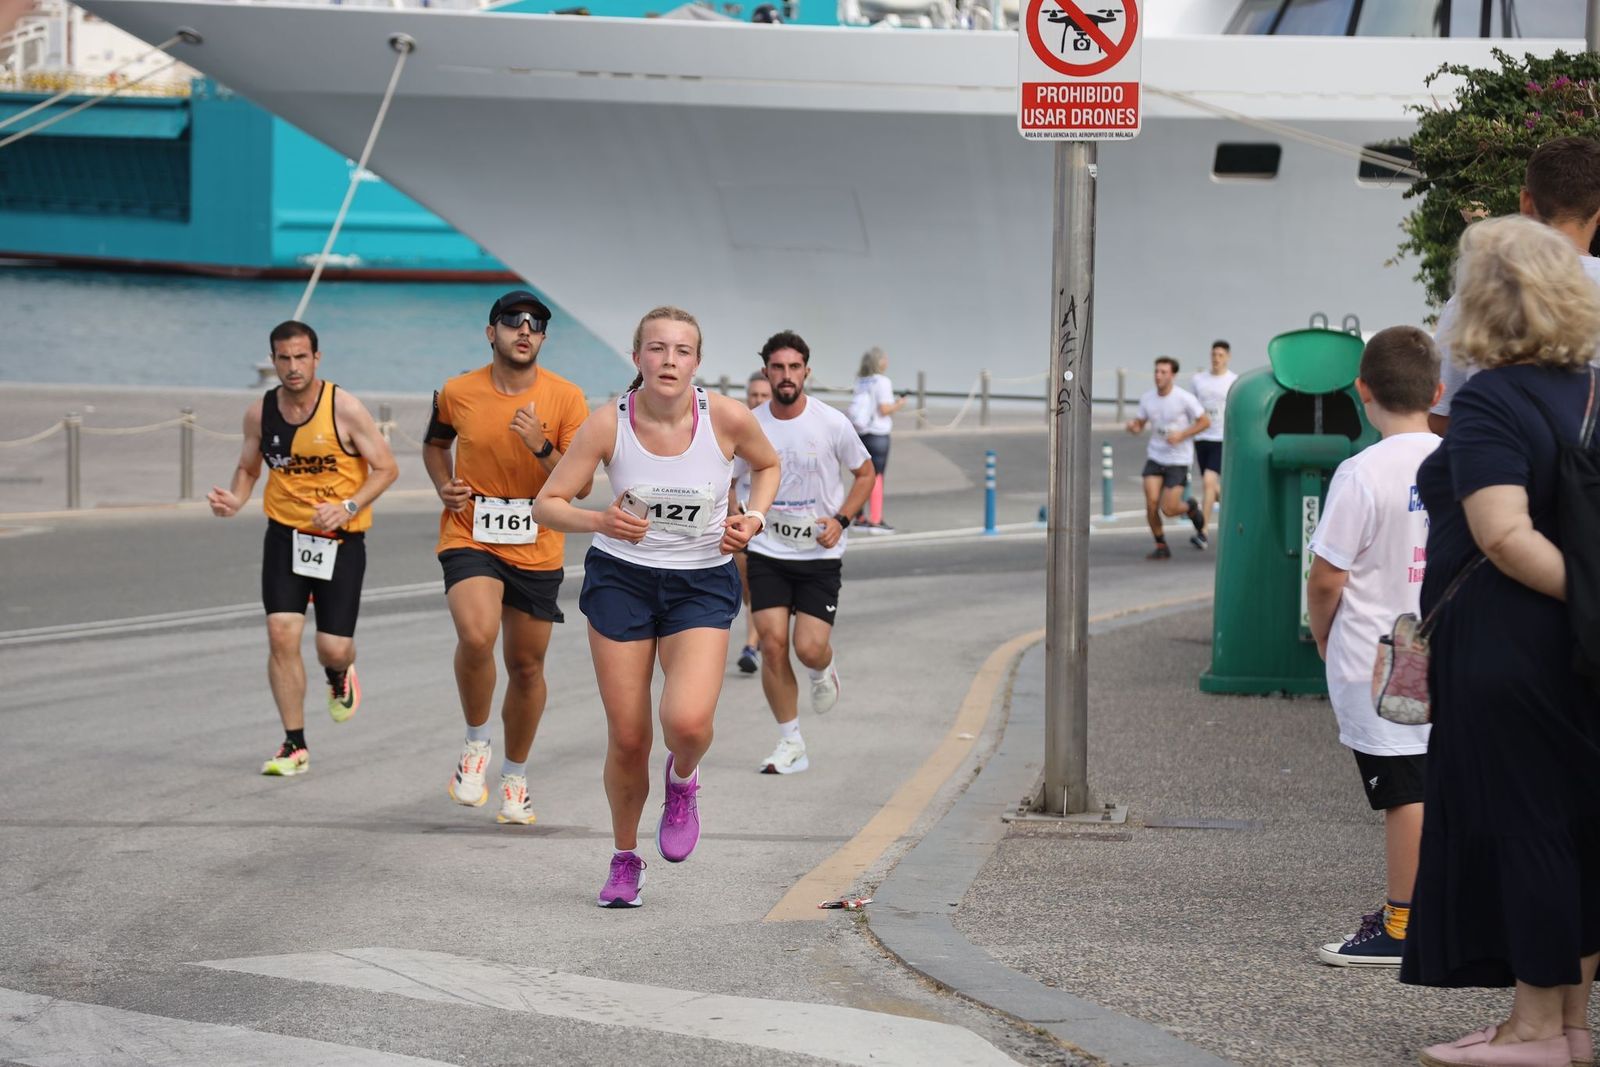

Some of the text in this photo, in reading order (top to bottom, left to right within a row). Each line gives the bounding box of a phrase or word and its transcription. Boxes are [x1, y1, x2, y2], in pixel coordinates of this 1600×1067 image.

[1036, 85, 1124, 103] PROHIBIDO
[1024, 108, 1136, 126] USAR DRONES
[650, 503, 701, 522] 127
[481, 513, 531, 531] 1161
[772, 522, 812, 538] 1074
